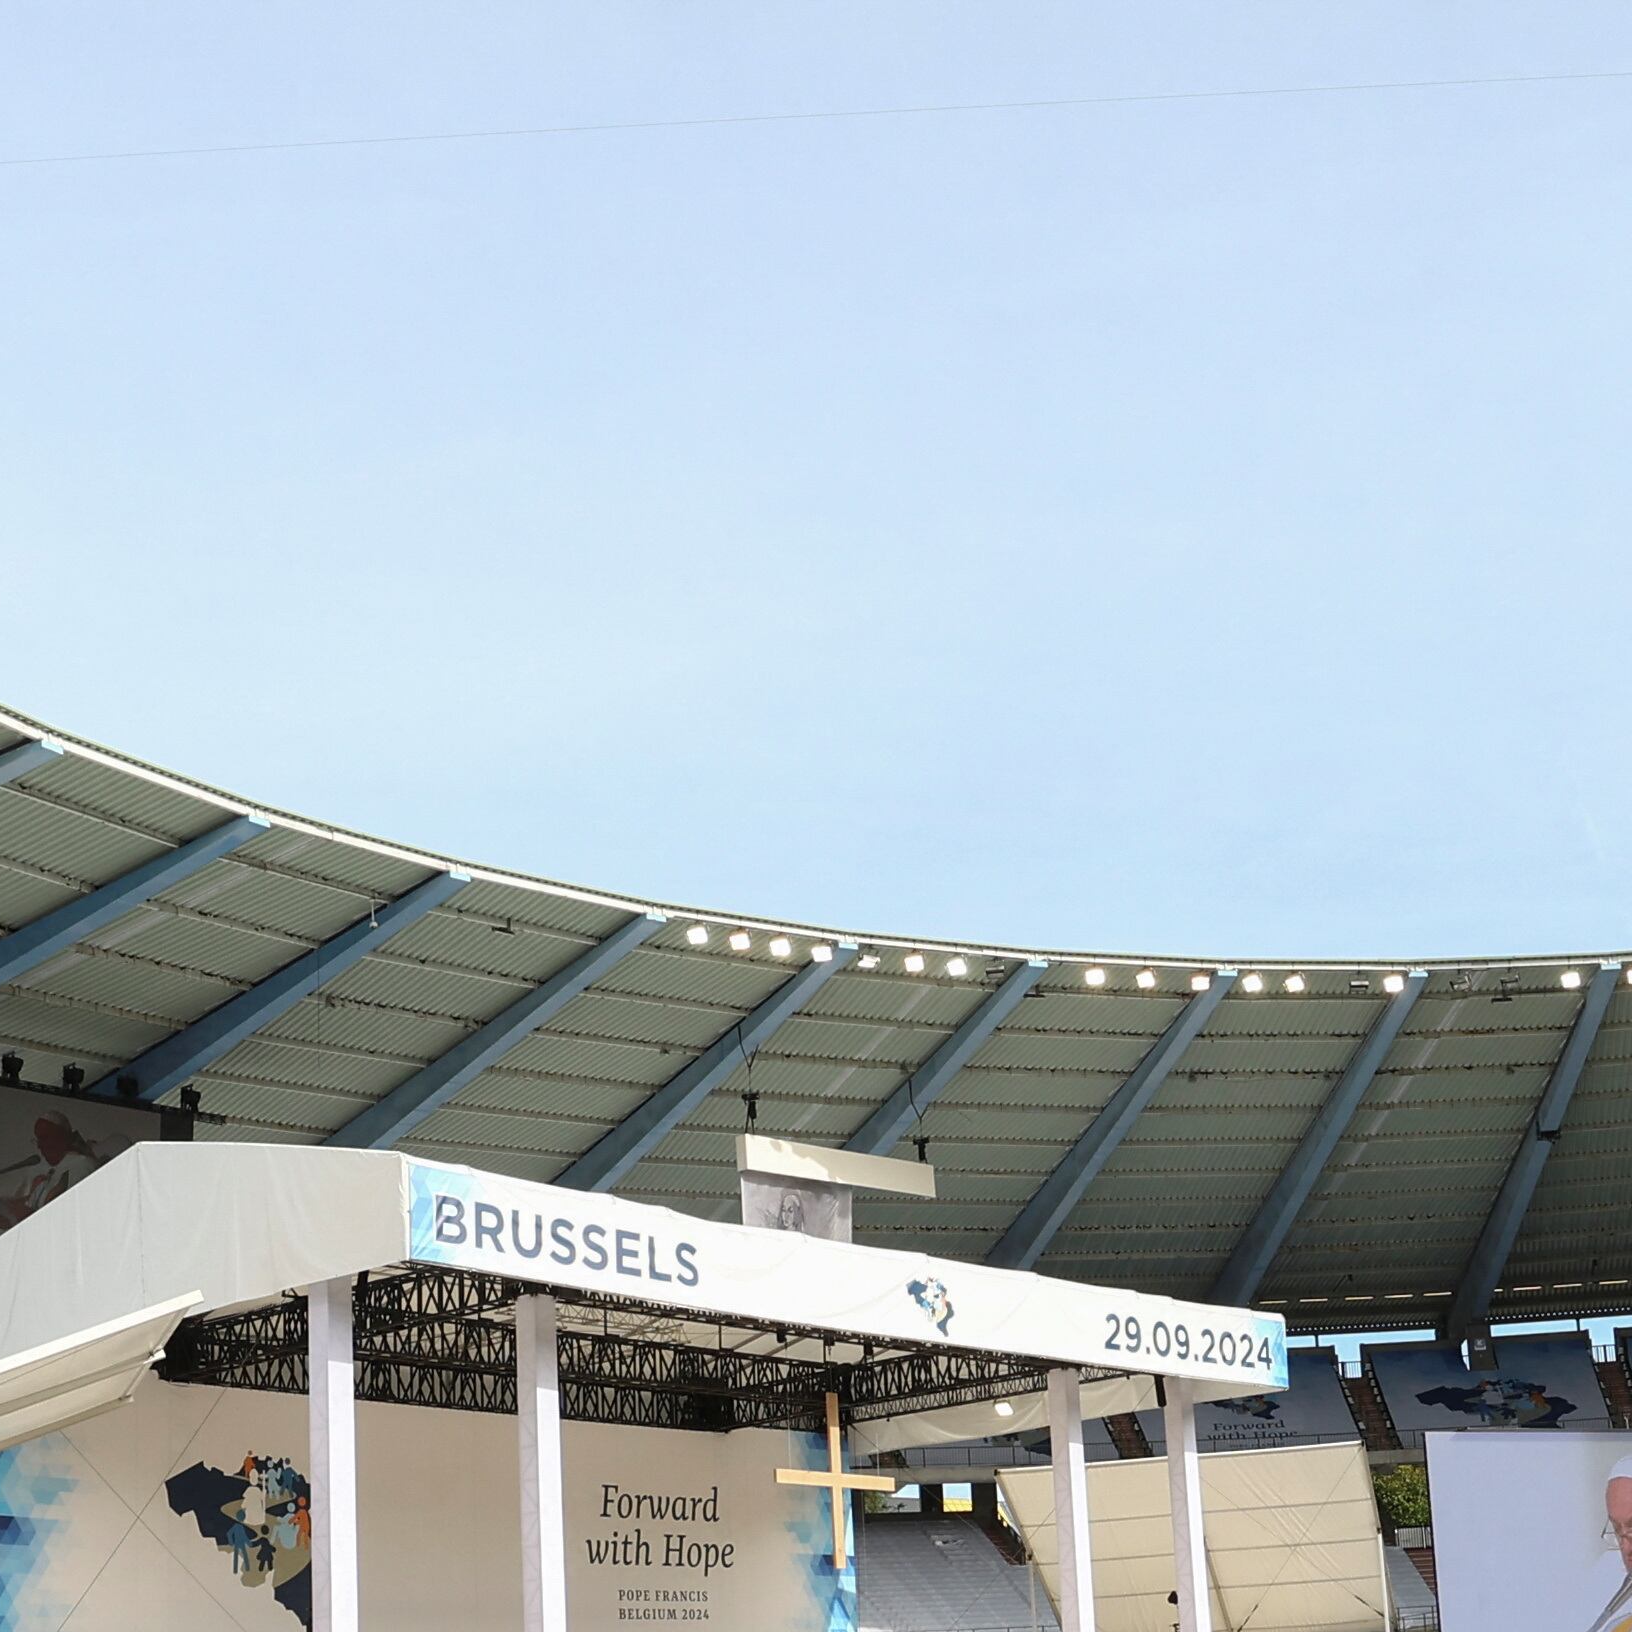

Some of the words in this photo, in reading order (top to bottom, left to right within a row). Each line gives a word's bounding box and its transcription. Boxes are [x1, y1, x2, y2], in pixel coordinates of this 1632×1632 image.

[434, 1194, 700, 1287] BRUSSELS
[1105, 1313, 1273, 1370] 29.09.2024
[1207, 1430, 1246, 1441] with
[1213, 1420, 1286, 1432] Forward
[600, 1484, 720, 1523] Forward
[585, 1528, 653, 1566] with
[662, 1533, 735, 1578] Hope
[618, 1590, 651, 1602] POPE
[655, 1591, 709, 1603] FRANCIS
[618, 1608, 678, 1621] BELGIUM
[681, 1608, 710, 1621] 2024
